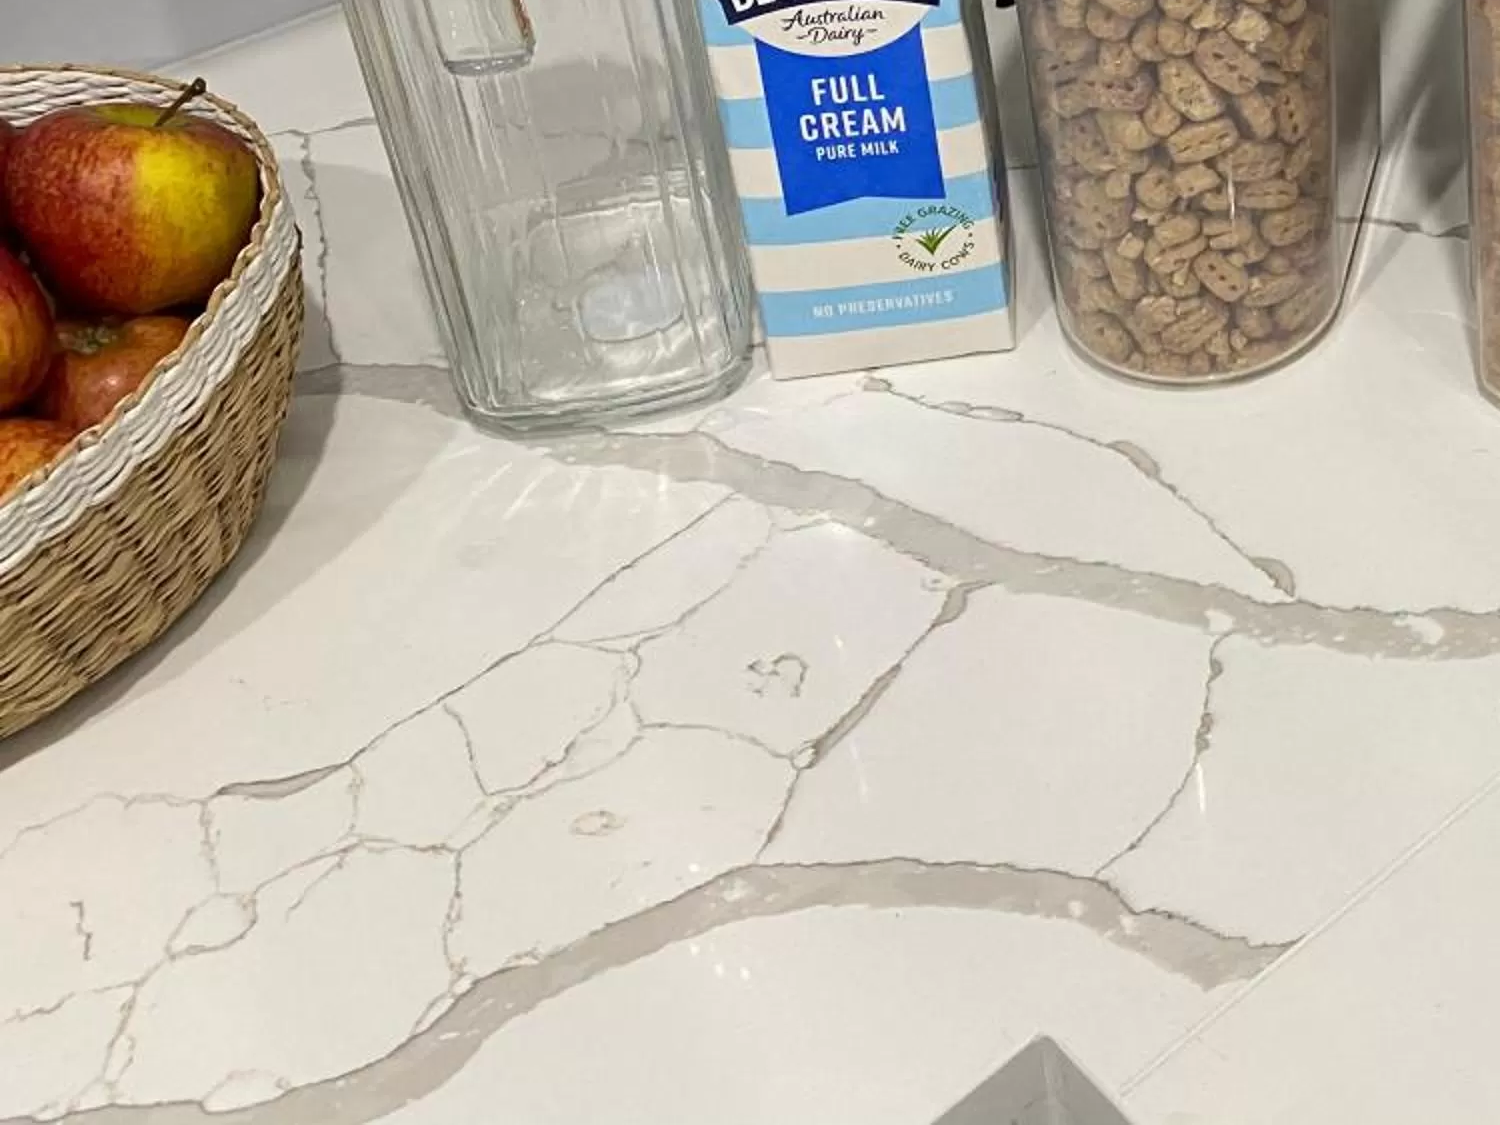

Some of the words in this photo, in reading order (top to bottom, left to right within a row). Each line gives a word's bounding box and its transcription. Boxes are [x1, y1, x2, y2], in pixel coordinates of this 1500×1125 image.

[781, 5, 885, 32] Australian
[811, 73, 884, 106] FULL
[799, 106, 906, 142] CREAM
[816, 144, 857, 161] PURE
[861, 141, 899, 157] MILK
[812, 305, 833, 319] NO
[838, 289, 954, 317] PRESERVATIVES
